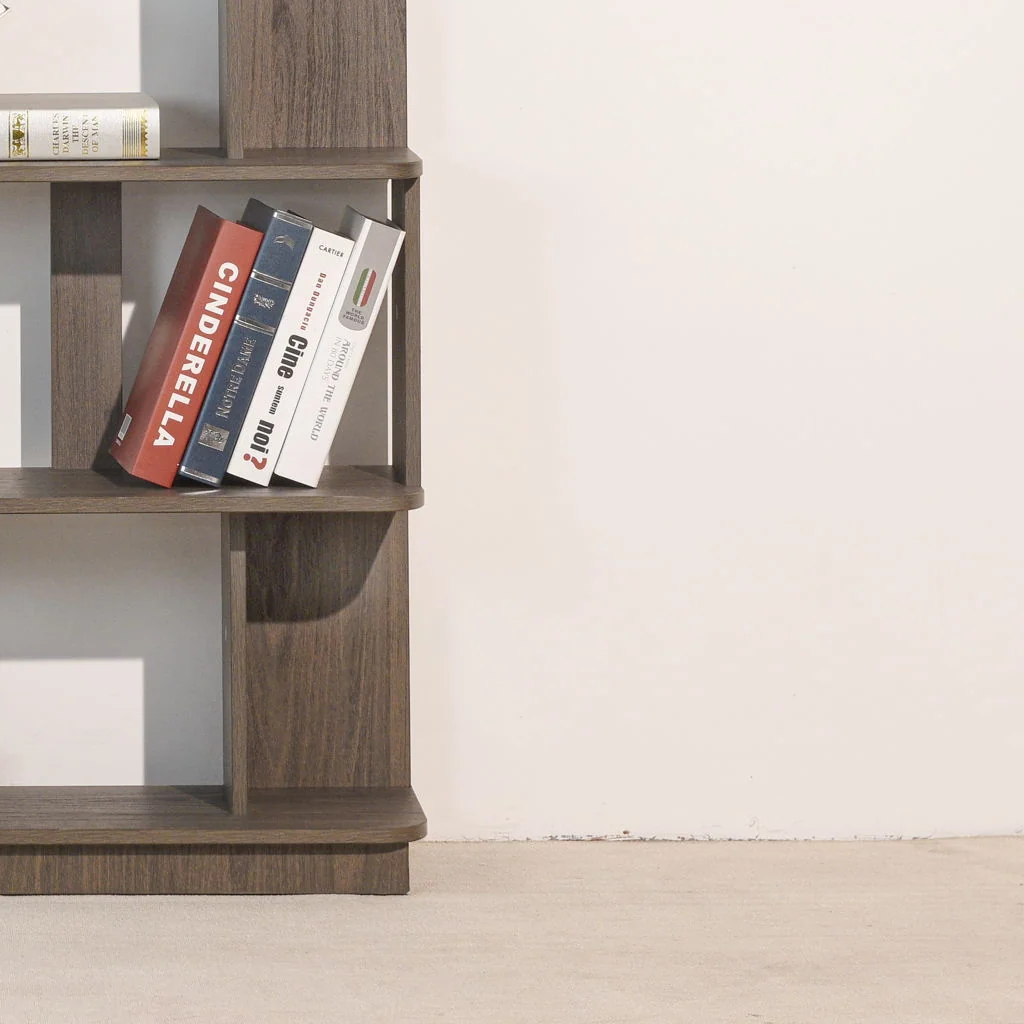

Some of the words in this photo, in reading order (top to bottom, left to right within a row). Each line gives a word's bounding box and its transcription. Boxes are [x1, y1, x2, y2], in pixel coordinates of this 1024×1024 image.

[92, 141, 98, 152] OF
[319, 245, 344, 258] CARTIER
[152, 262, 238, 446] CINDERELLA
[278, 335, 308, 379] Cine
[332, 338, 351, 381] AROUND
[269, 386, 284, 415] suntem
[323, 384, 336, 403] THE
[311, 407, 328, 441] WORLD
[243, 420, 274, 470] noi?
